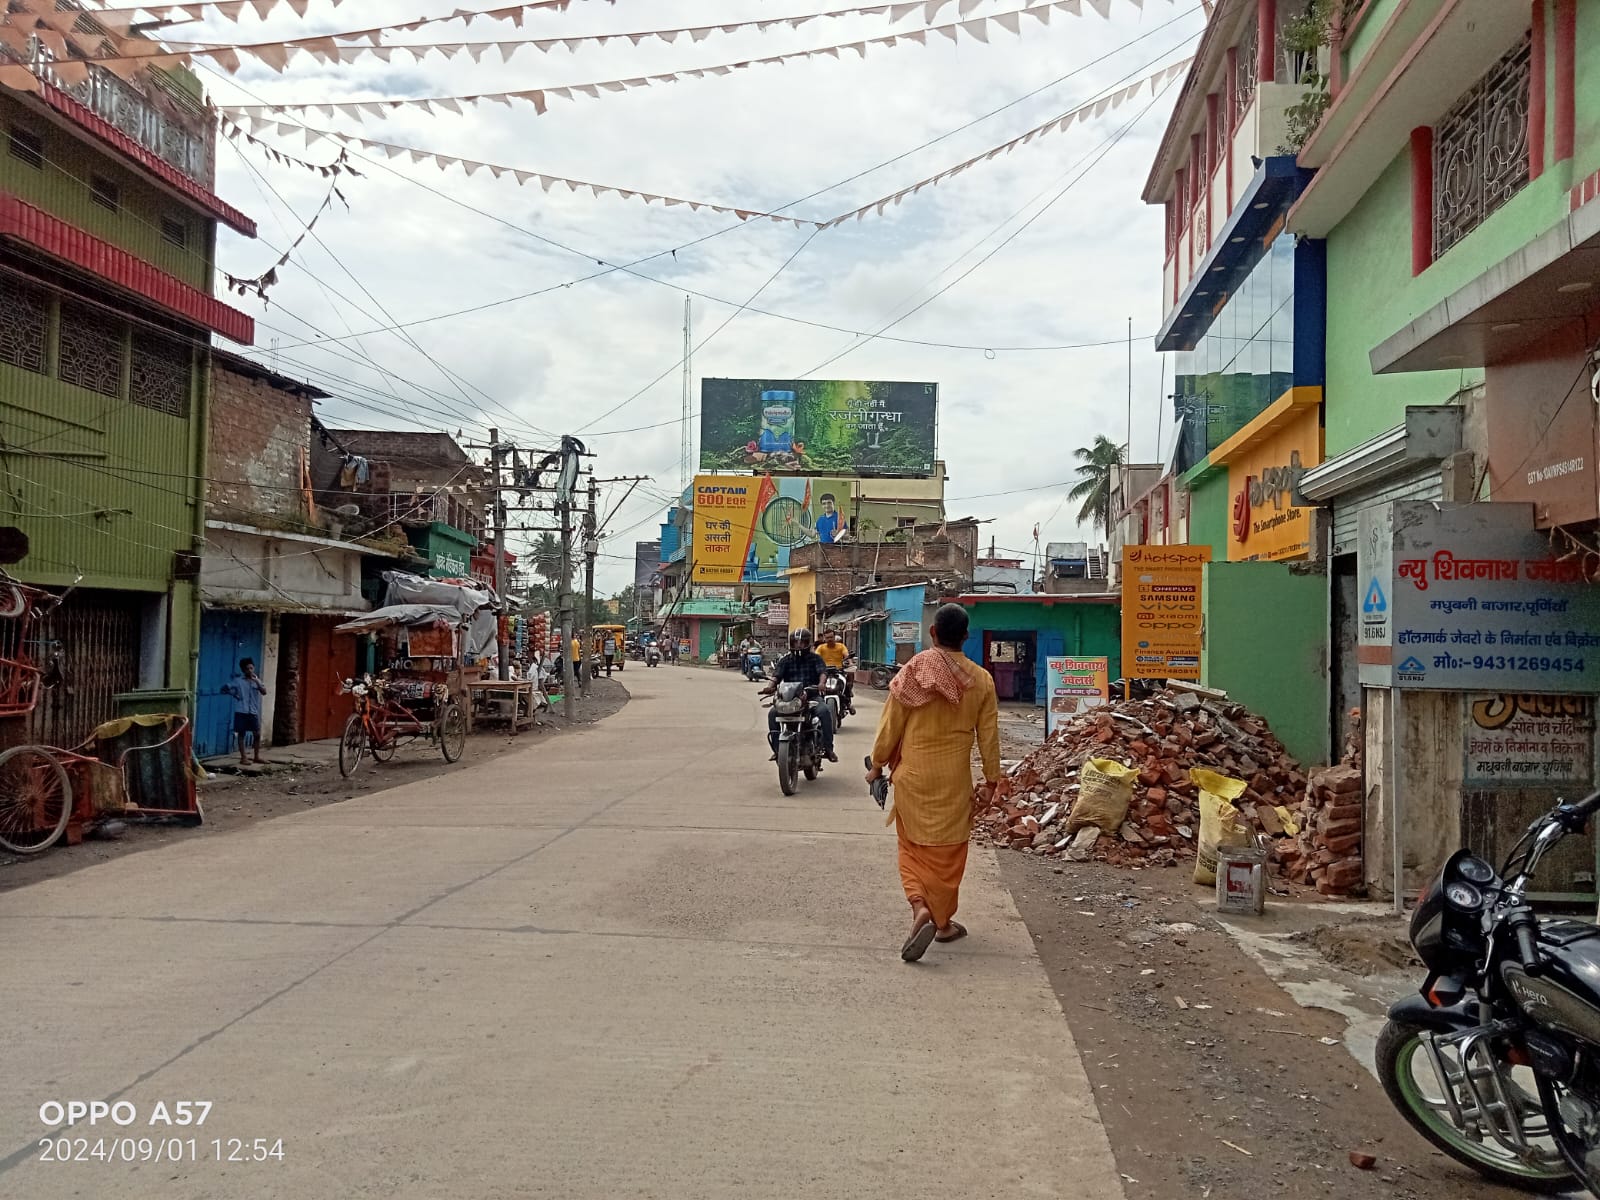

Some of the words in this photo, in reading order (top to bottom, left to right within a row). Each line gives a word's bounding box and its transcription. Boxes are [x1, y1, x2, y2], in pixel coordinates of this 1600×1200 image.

[829, 408, 904, 423] रजनीगन्धा
[698, 486, 747, 494] CAPTAIN
[697, 494, 724, 505] 600
[726, 497, 746, 505] EQR
[705, 521, 718, 530] घर
[719, 519, 731, 530] की
[1260, 513, 1286, 531] Smartphone
[705, 531, 731, 542] असली
[705, 544, 731, 552] ताकत
[1433, 549, 1518, 581] शिवनाथ
[1140, 602, 1195, 610] vivo
[1430, 597, 1477, 614] मधुबनी
[1138, 622, 1195, 630] oppo
[1485, 630, 1496, 644] के
[1500, 629, 1541, 646] निर्माता
